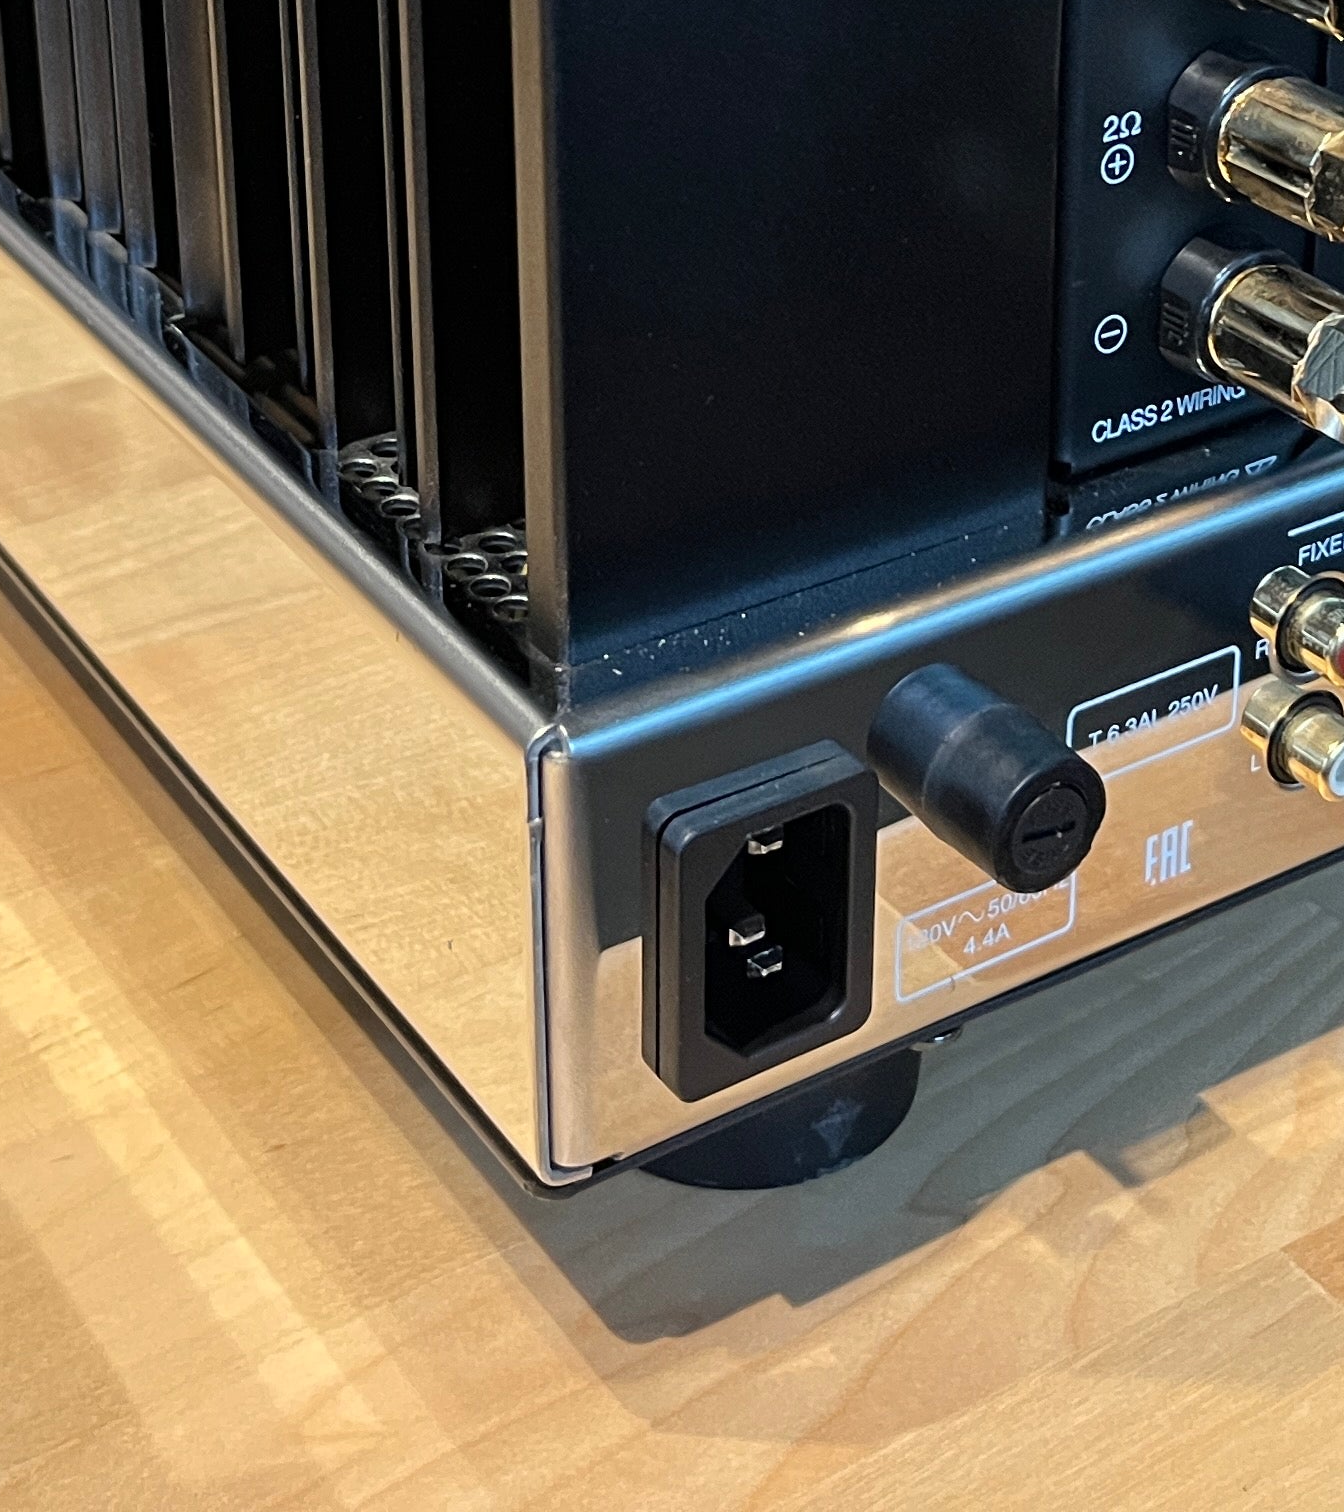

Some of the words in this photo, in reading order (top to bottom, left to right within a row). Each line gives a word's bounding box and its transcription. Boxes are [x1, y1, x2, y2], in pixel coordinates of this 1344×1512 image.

[1091, 404, 1158, 444] CLASS
[1159, 399, 1174, 422] 2
[1168, 683, 1219, 721] 250V
[963, 922, 1012, 955] 4.4A
